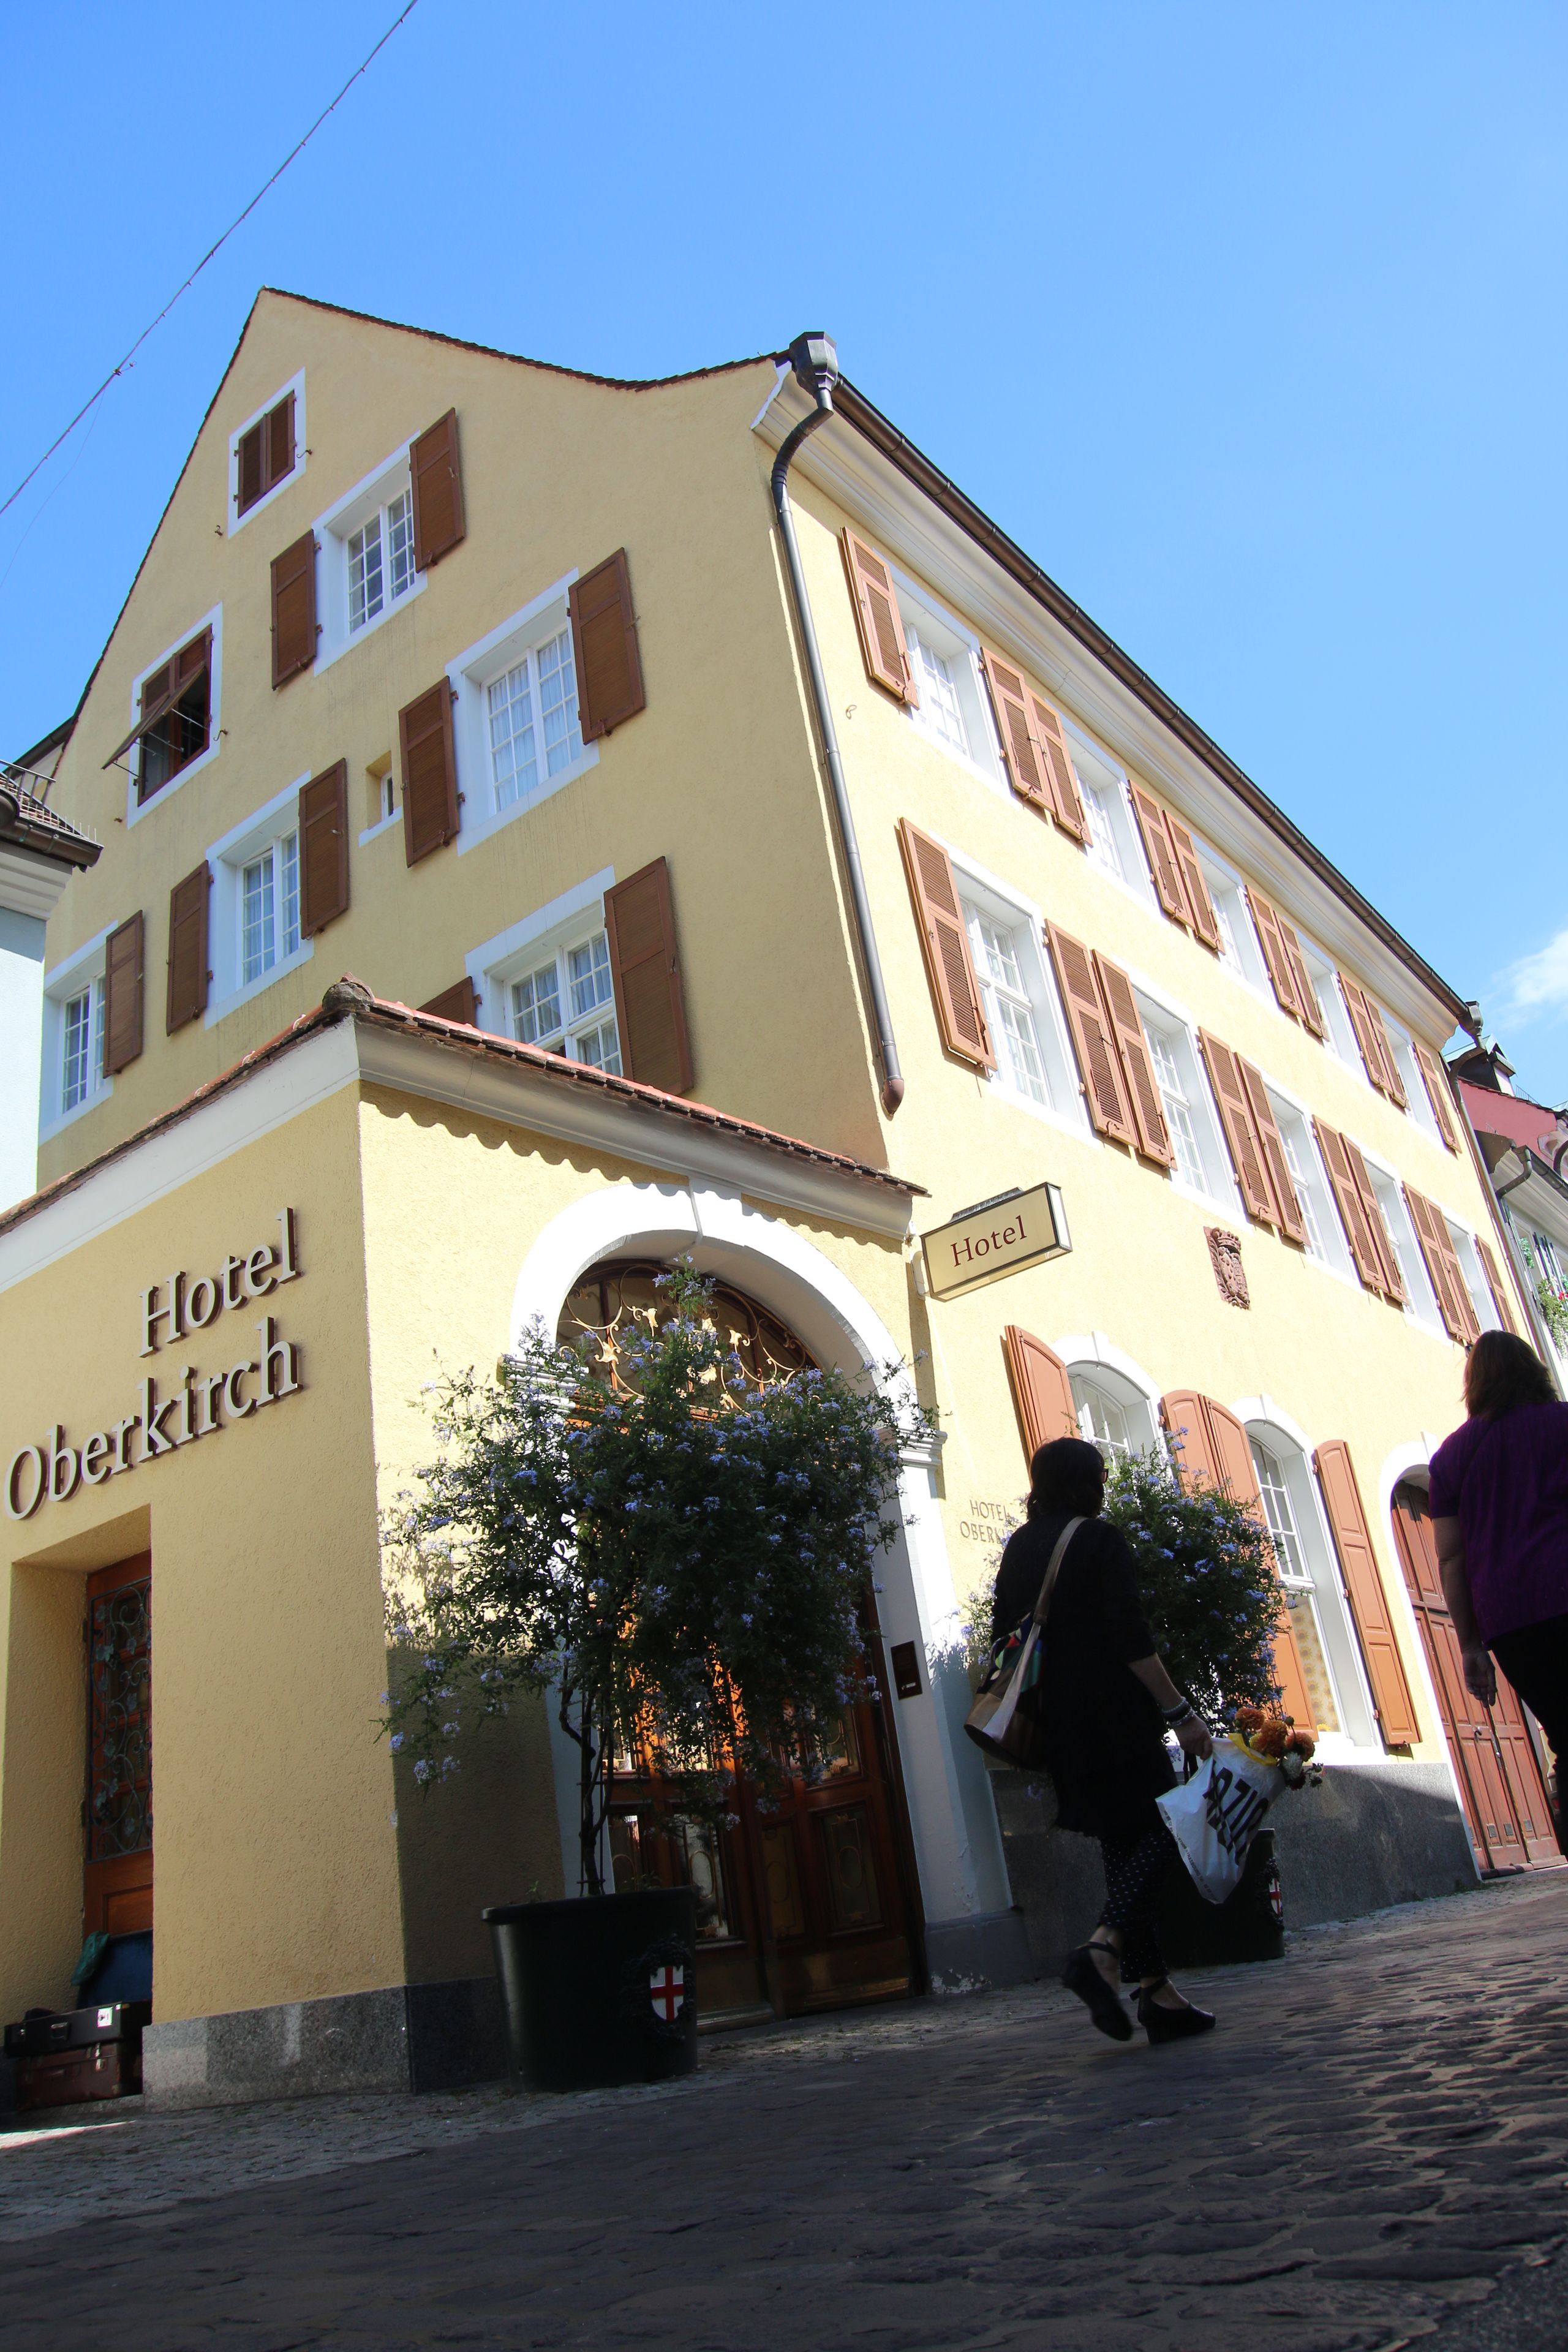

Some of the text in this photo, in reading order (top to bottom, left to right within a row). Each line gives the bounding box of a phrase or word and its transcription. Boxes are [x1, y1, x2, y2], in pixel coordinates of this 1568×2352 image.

[139, 1207, 301, 1358] Hotel
[951, 1215, 1027, 1267] Hotel
[4, 1317, 302, 1520] Oberkirch
[970, 1499, 1009, 1521] HOTEL
